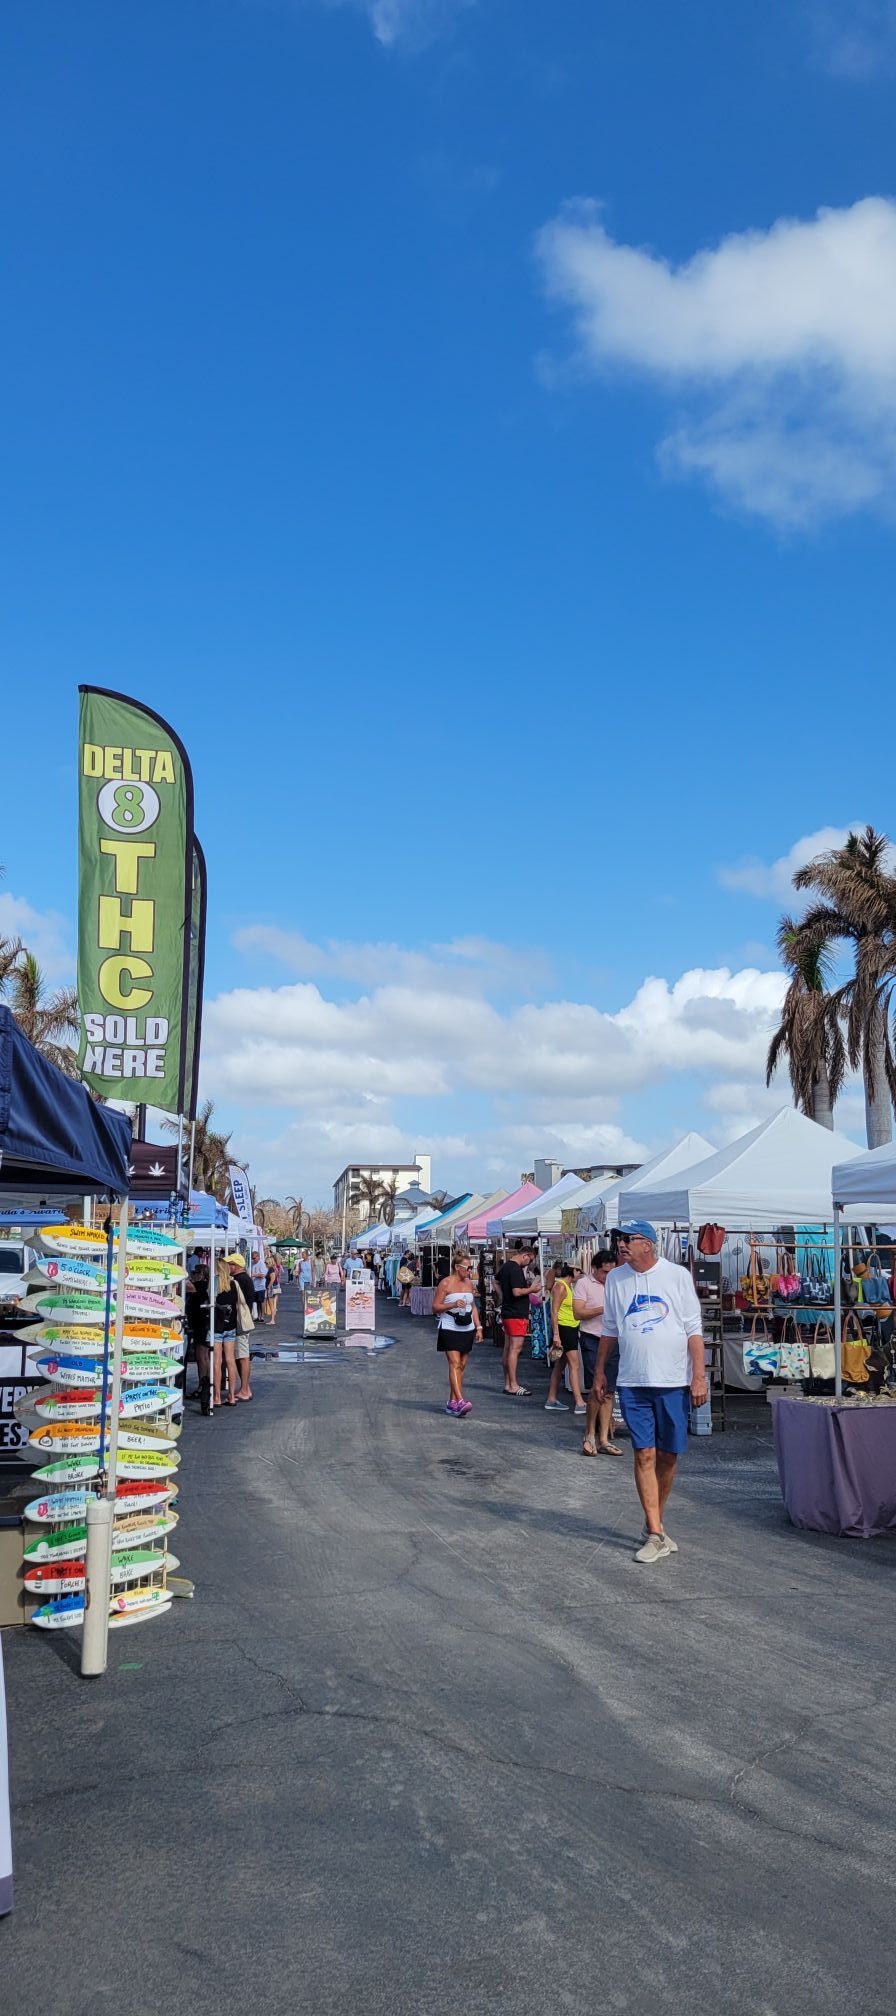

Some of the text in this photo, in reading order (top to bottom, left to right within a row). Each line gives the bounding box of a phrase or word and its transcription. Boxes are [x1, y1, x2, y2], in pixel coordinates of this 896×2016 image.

[83, 743, 176, 784] DELTA
[111, 784, 145, 828] 8
[98, 838, 156, 1011] THC
[86, 1013, 169, 1046] SOLD
[82, 1044, 166, 1078] HERE
[233, 1179, 246, 1211] SLEEP
[69, 1228, 85, 1237] SWIM
[60, 1263, 68, 1272] 5
[125, 1392, 141, 1403] PARTY
